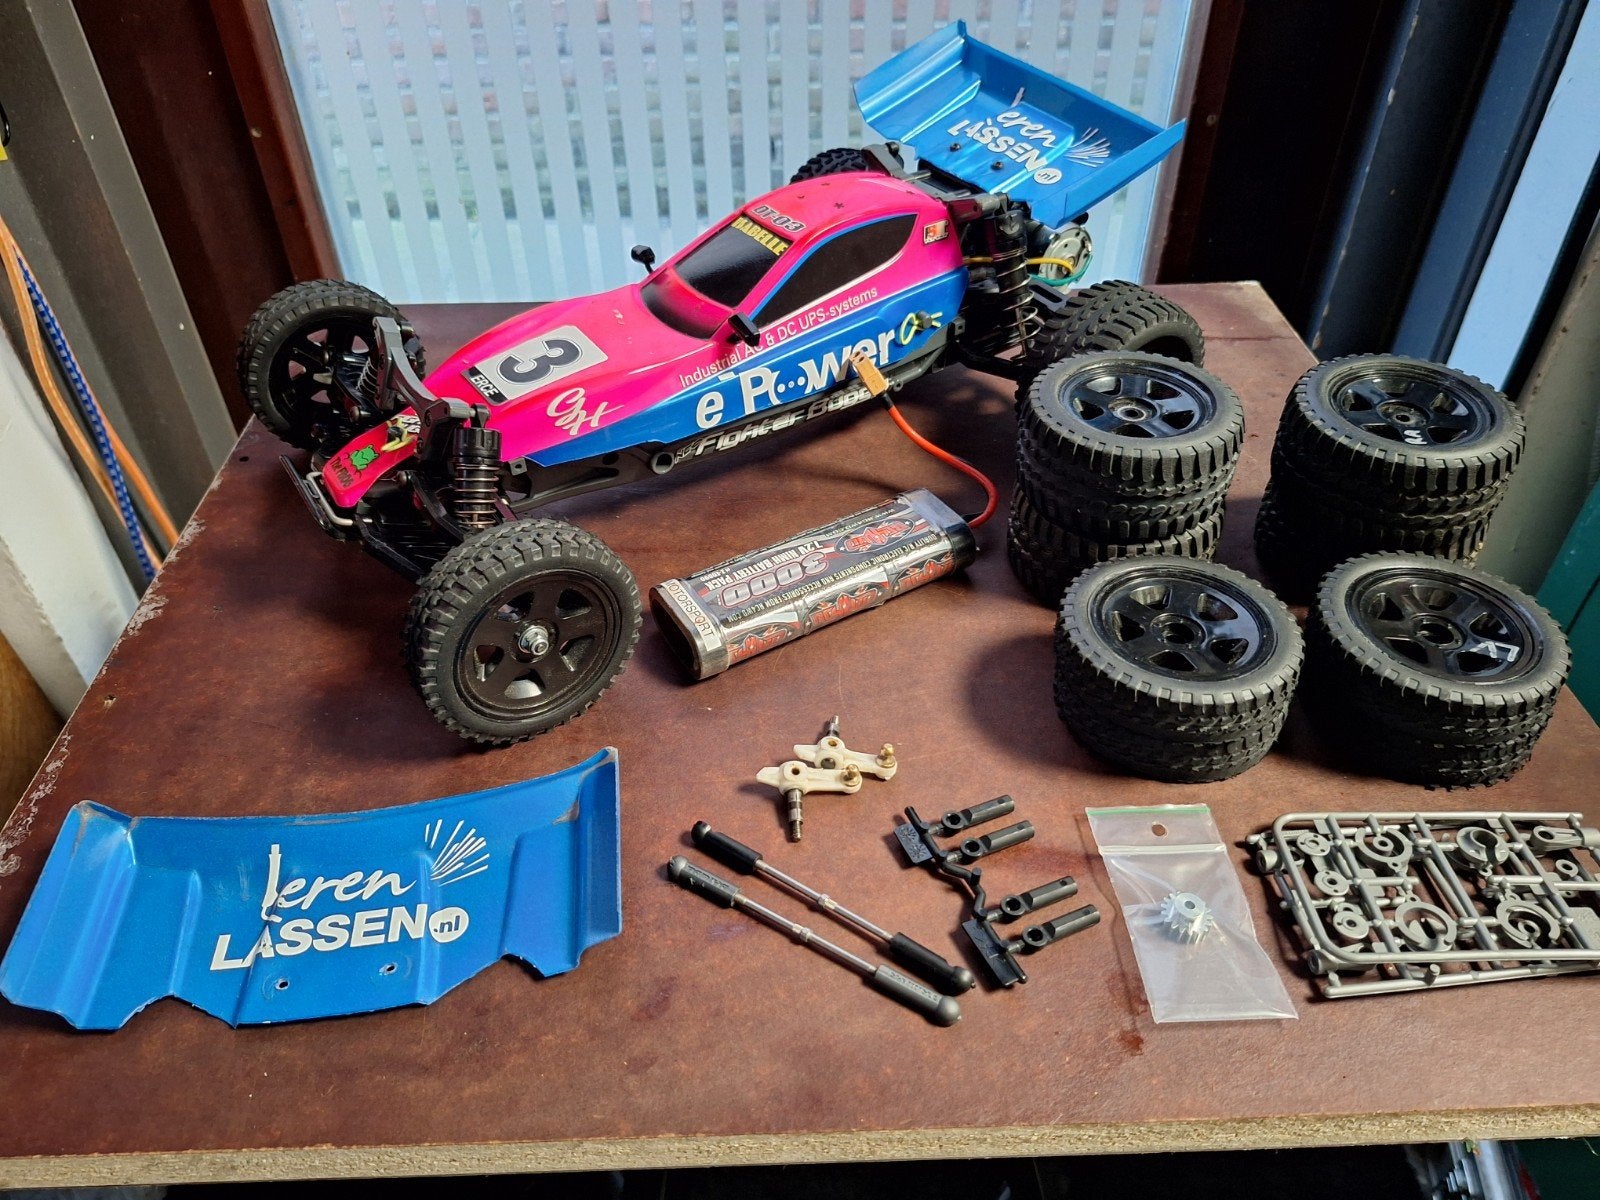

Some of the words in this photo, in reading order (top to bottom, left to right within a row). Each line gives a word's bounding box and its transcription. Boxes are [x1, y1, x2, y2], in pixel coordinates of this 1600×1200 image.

[752, 205, 806, 232] DT-03
[679, 346, 741, 388] Industrial
[766, 333, 775, 347] &
[777, 321, 797, 341] DC
[800, 287, 878, 331] UPS-systems
[497, 339, 582, 386] 3
[704, 576, 734, 591] PACK
[721, 551, 828, 608] 3000
[734, 559, 774, 581] BATTERY
